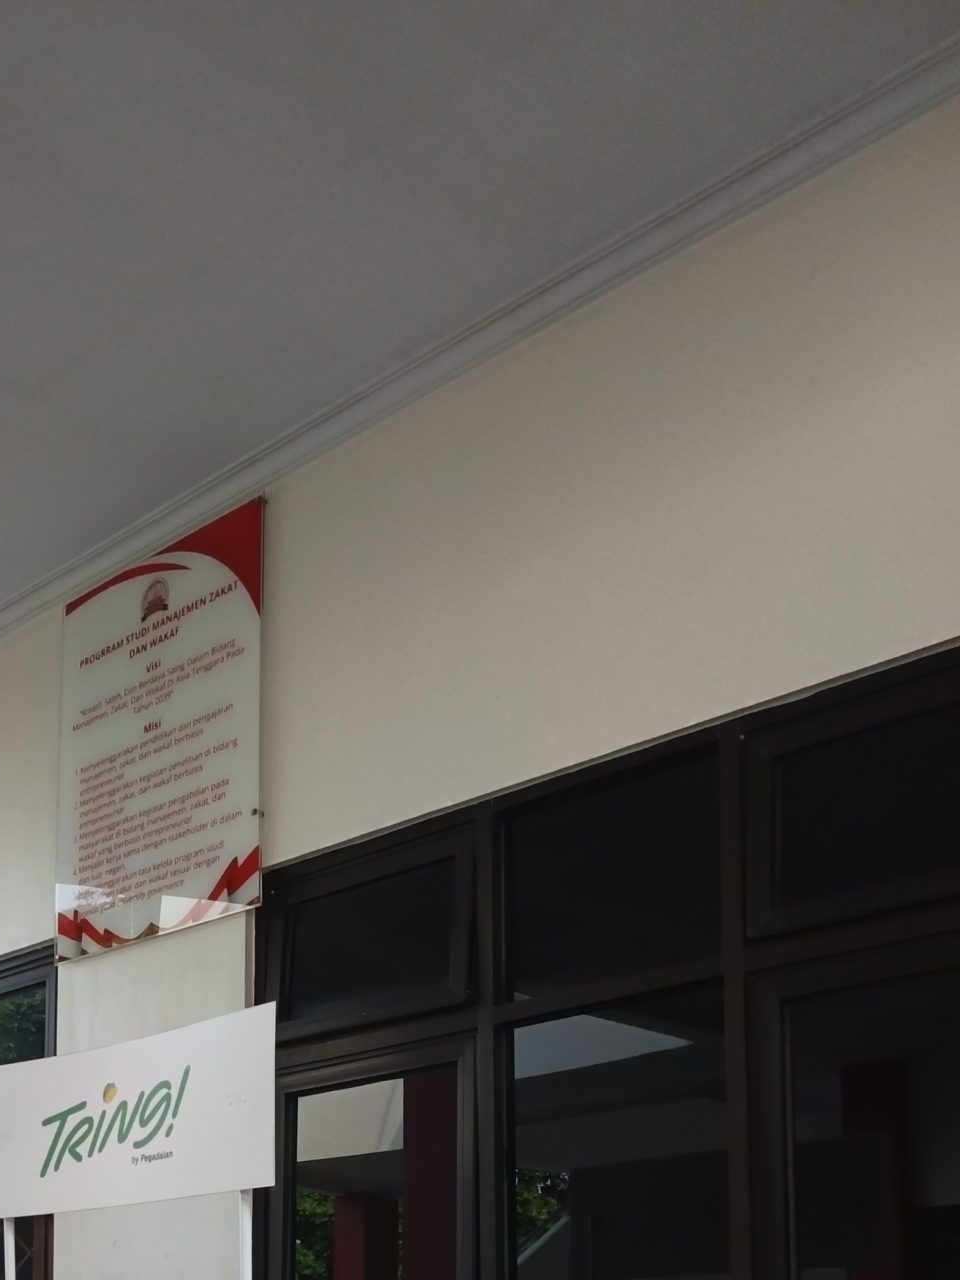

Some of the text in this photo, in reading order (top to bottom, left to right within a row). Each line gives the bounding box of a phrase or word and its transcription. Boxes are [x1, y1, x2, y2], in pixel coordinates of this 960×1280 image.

[79, 580, 237, 667] PROGRRAM STUDI MANAJEMEN ZAKAT
[129, 626, 178, 658] DAN WAKAF
[186, 651, 209, 666] Dalam
[210, 638, 235, 655] Bidang
[145, 660, 160, 672] Visi
[192, 656, 224, 674] Tenggara
[225, 646, 244, 659] Pada
[80, 744, 138, 772] Menyelenggarakan
[139, 728, 176, 749] pendidikan
[177, 721, 191, 732] dan
[192, 703, 232, 727] pengajaran
[143, 721, 161, 733] Misi
[138, 750, 151, 760] dan
[152, 739, 172, 753] wakaf
[173, 729, 203, 745] berbasis
[79, 779, 137, 806] Menyelenggarakan
[139, 767, 166, 782] kegiatan
[212, 737, 237, 753] bidang
[138, 785, 151, 795] dan
[152, 774, 171, 789] wakaf
[173, 764, 203, 781] berbasis
[79, 814, 137, 839] Menyelenggarakan
[138, 802, 166, 817] kegiatan
[168, 786, 209, 808] pengabdian
[210, 778, 229, 792] pada
[122, 821, 144, 835] bidang
[211, 791, 225, 802] dan
[78, 859, 104, 872] Menjalin
[105, 853, 121, 864] kerja
[122, 847, 140, 857] sama
[141, 837, 166, 851] dengan
[168, 823, 207, 841] stakeholder
[219, 810, 242, 824] dalam
[113, 835, 140, 850] berbasis
[133, 879, 147, 889] dan
[192, 855, 219, 869] dengan
[138, 866, 151, 876] tata
[152, 859, 172, 870] kelola
[174, 848, 204, 865] program
[206, 840, 224, 852] studi
[78, 876, 90, 885] dan
[131, 1150, 174, 1166] by Pegadaian
